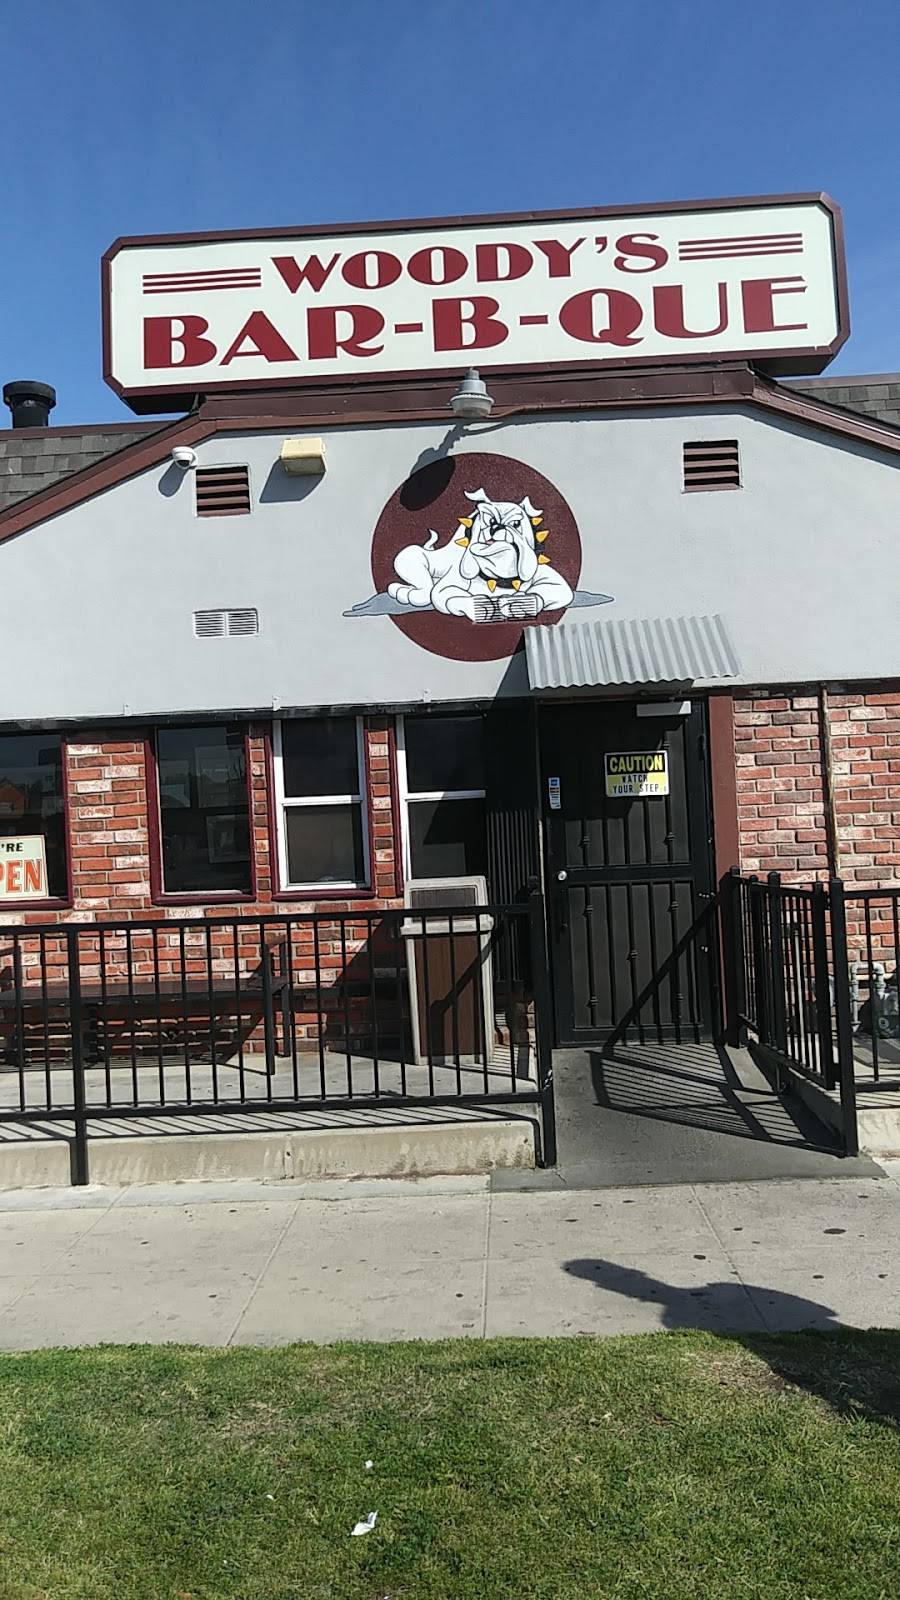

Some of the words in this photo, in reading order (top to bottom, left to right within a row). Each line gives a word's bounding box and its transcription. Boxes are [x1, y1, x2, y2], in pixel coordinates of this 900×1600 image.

[271, 233, 669, 294] WOODY'S
[143, 275, 809, 370] BAR-B-QUE
[609, 754, 663, 772] CAUTION
[621, 774, 648, 783] WATCH
[612, 784, 634, 794] YOUR
[639, 783, 659, 793] STEP
